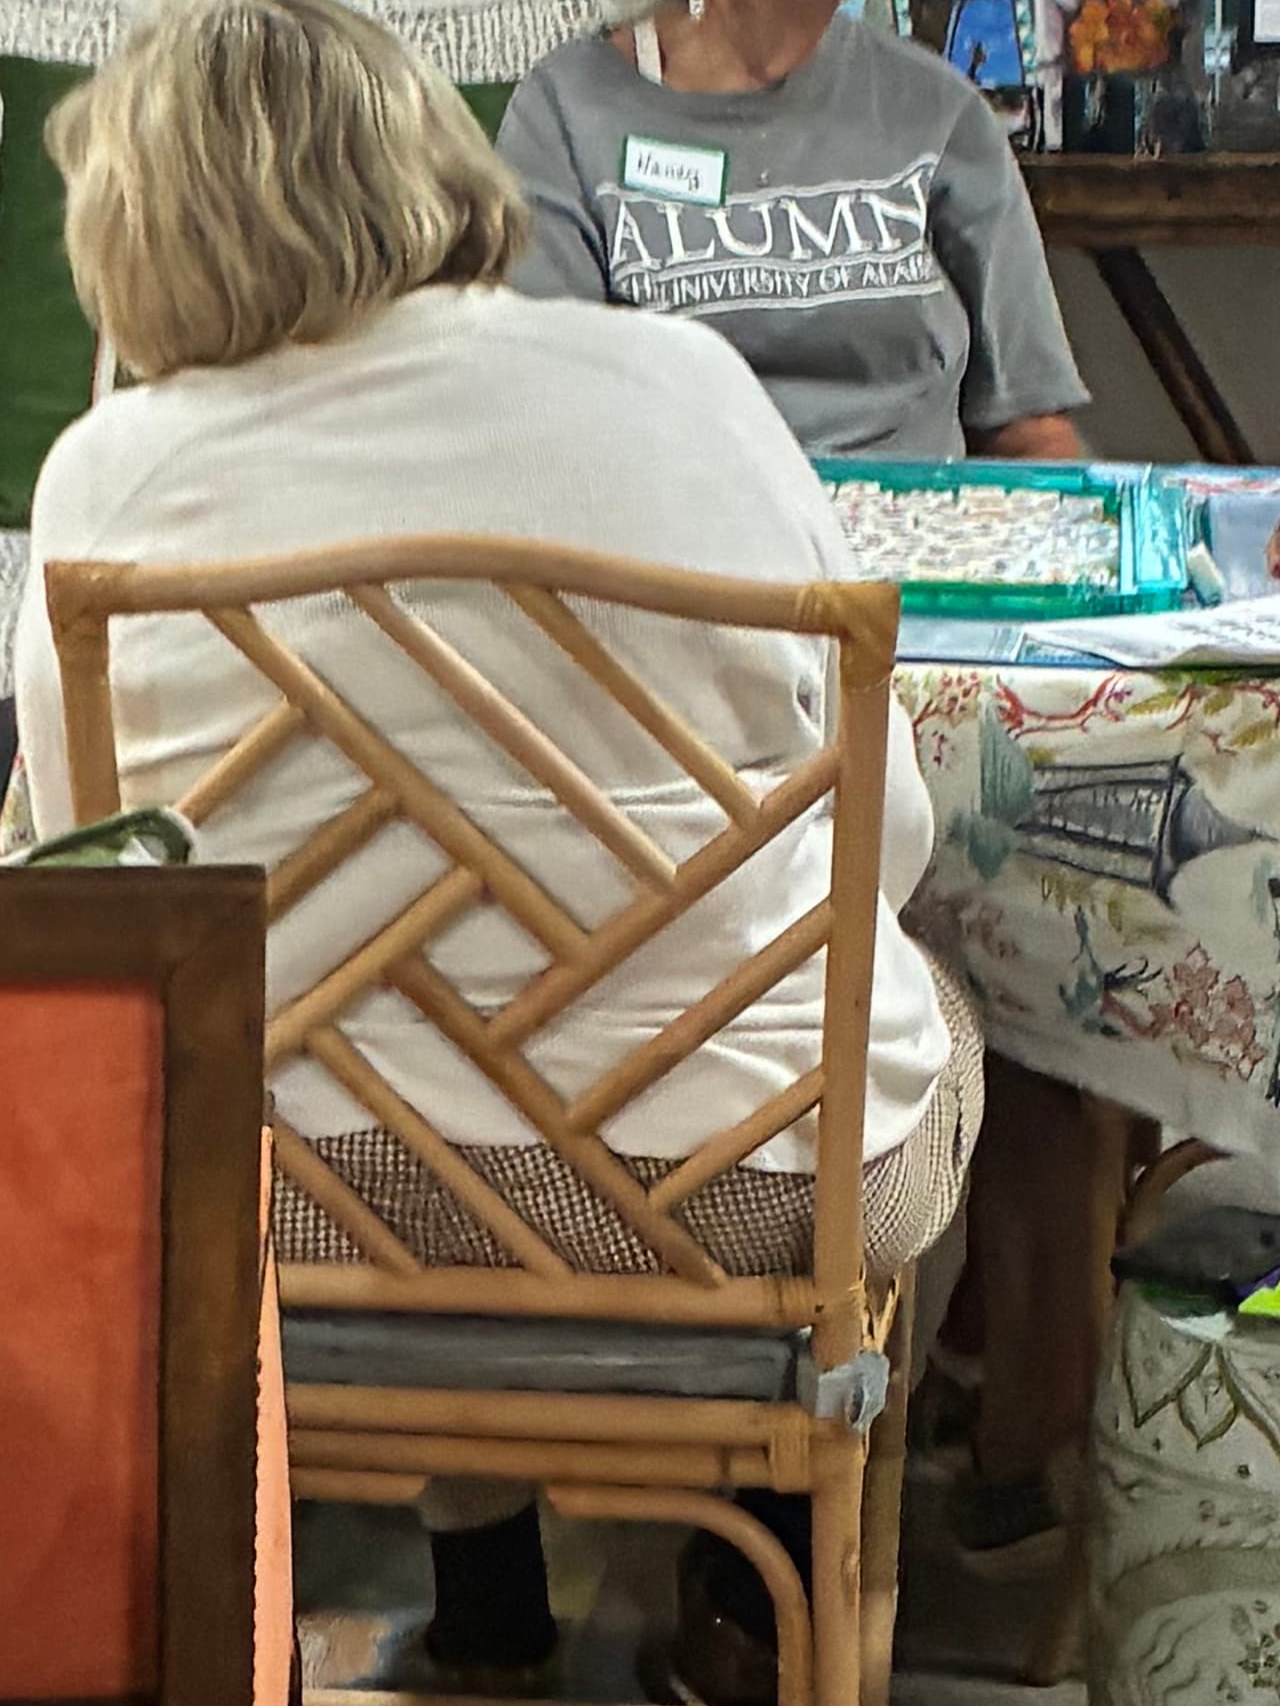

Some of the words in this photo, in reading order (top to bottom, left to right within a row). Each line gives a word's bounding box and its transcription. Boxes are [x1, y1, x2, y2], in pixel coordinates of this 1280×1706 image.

[609, 167, 929, 271] ALUMN
[661, 267, 811, 306] UNIVERSITY
[819, 264, 850, 292] OF
